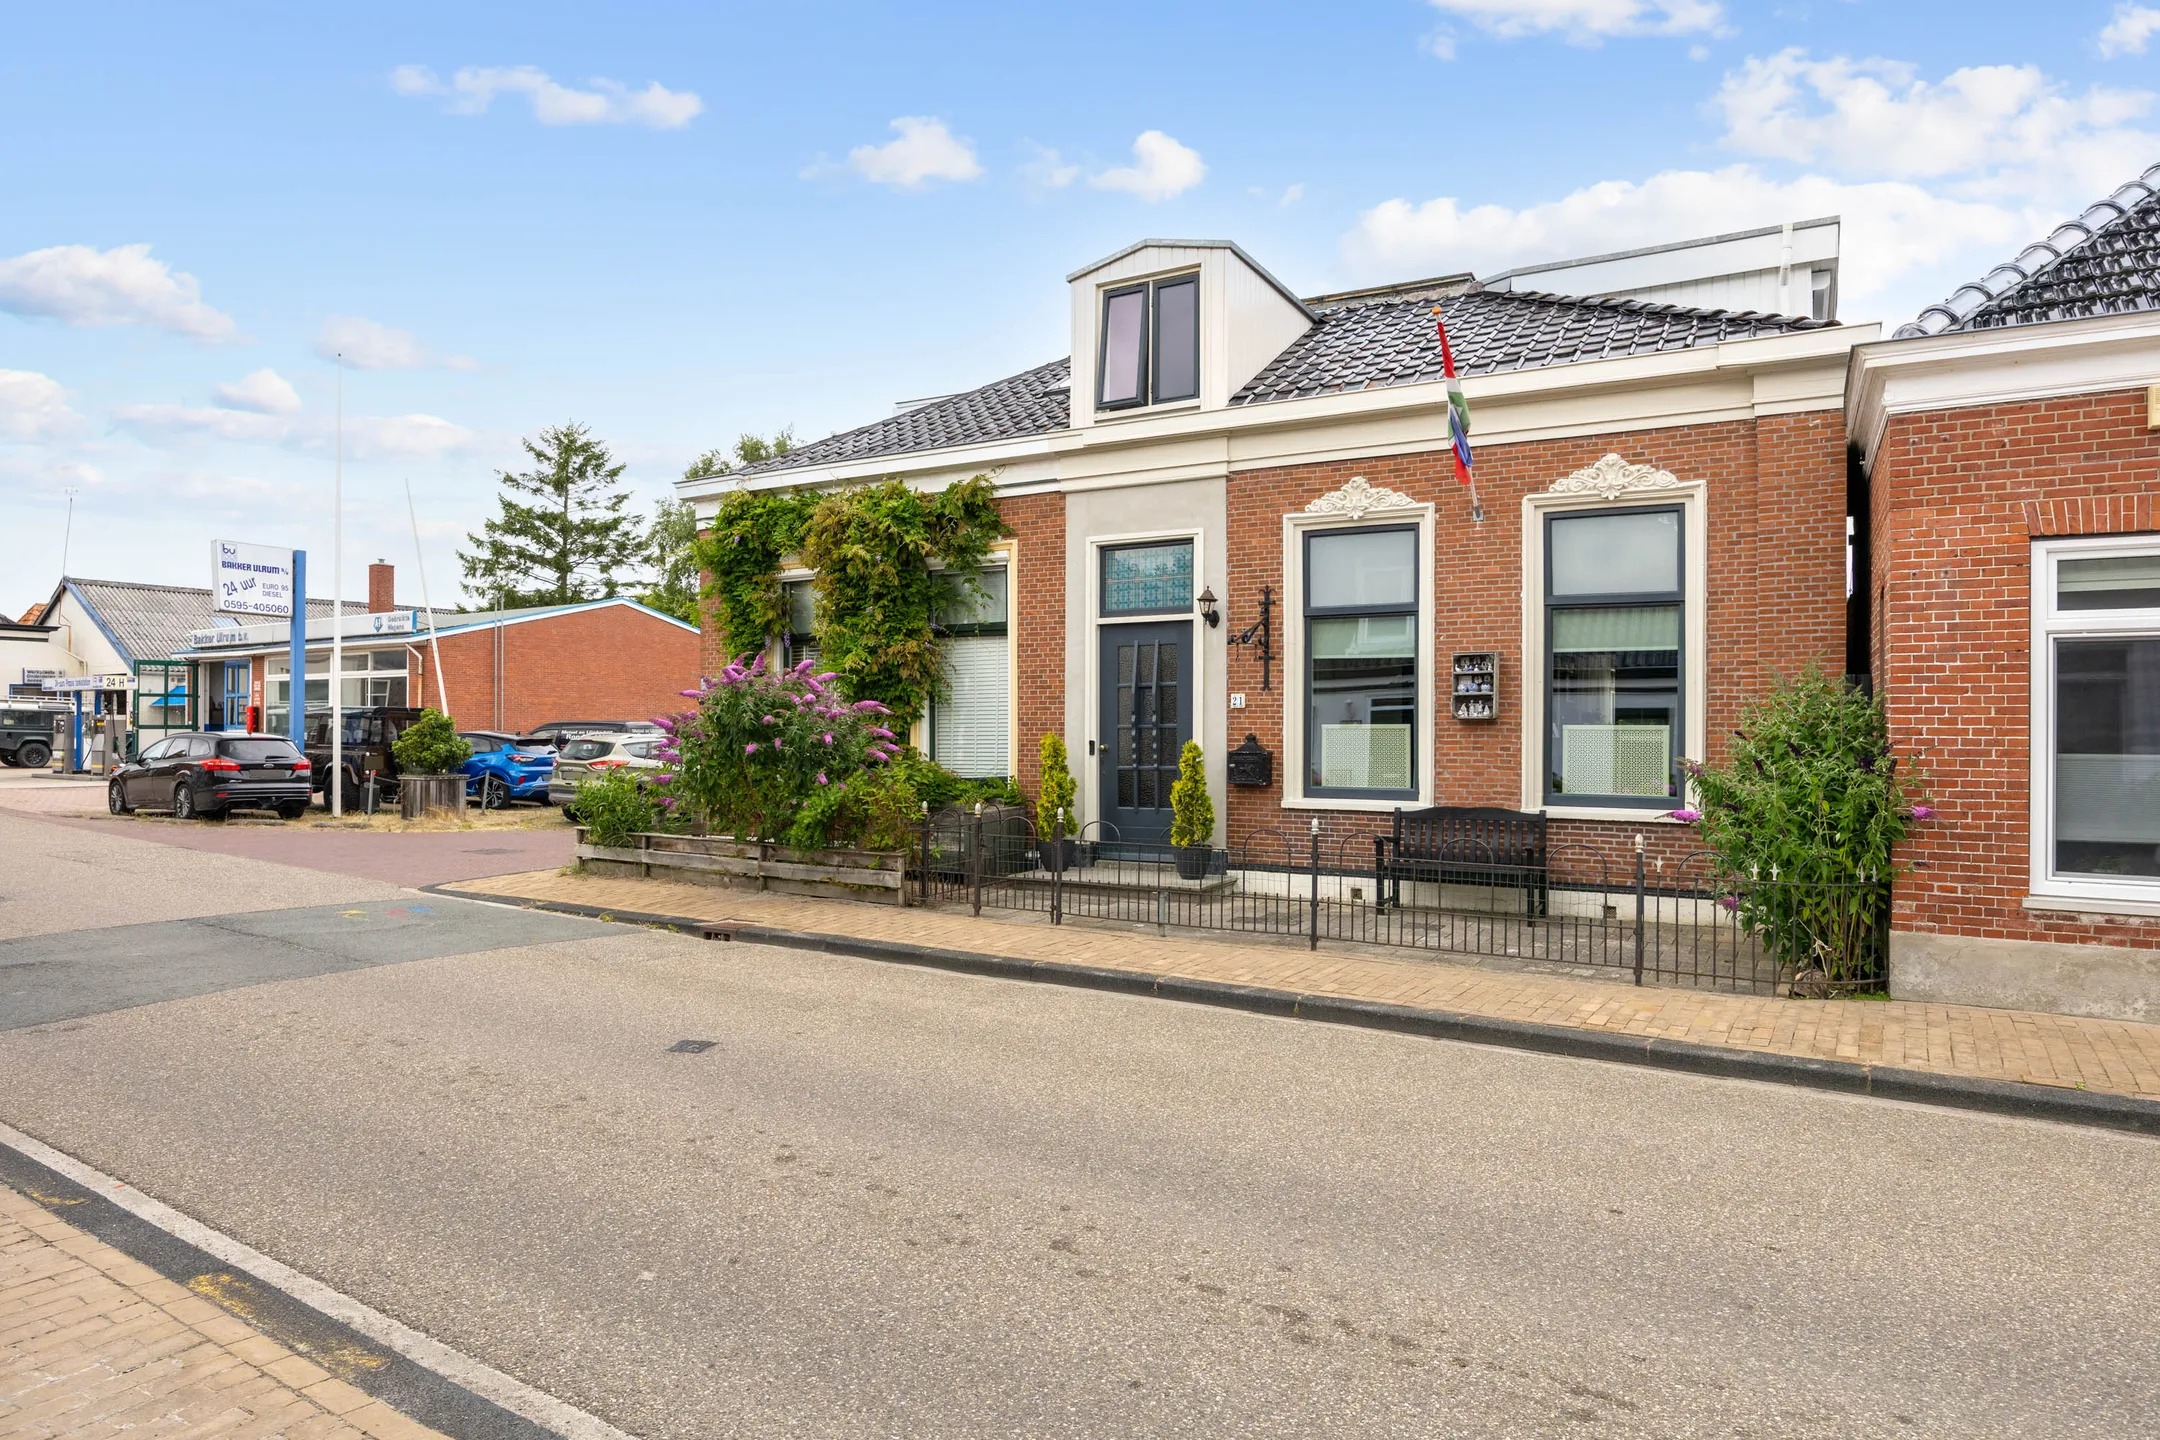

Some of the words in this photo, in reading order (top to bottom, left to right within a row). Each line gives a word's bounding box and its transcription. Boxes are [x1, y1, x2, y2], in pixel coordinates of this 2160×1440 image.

[221, 560, 252, 571] BAKKER
[253, 564, 280, 575] ULRUM
[222, 581, 239, 596] 24
[239, 577, 257, 591] uur
[262, 582, 279, 591] EURO
[281, 584, 289, 592] 95
[262, 590, 283, 598] DIESEL
[223, 599, 289, 614] 0595-405060
[193, 634, 215, 645] Bakker
[216, 631, 236, 643] Ulrum
[106, 677, 116, 687] 24
[119, 678, 125, 687] H
[1232, 696, 1242, 706] 21
